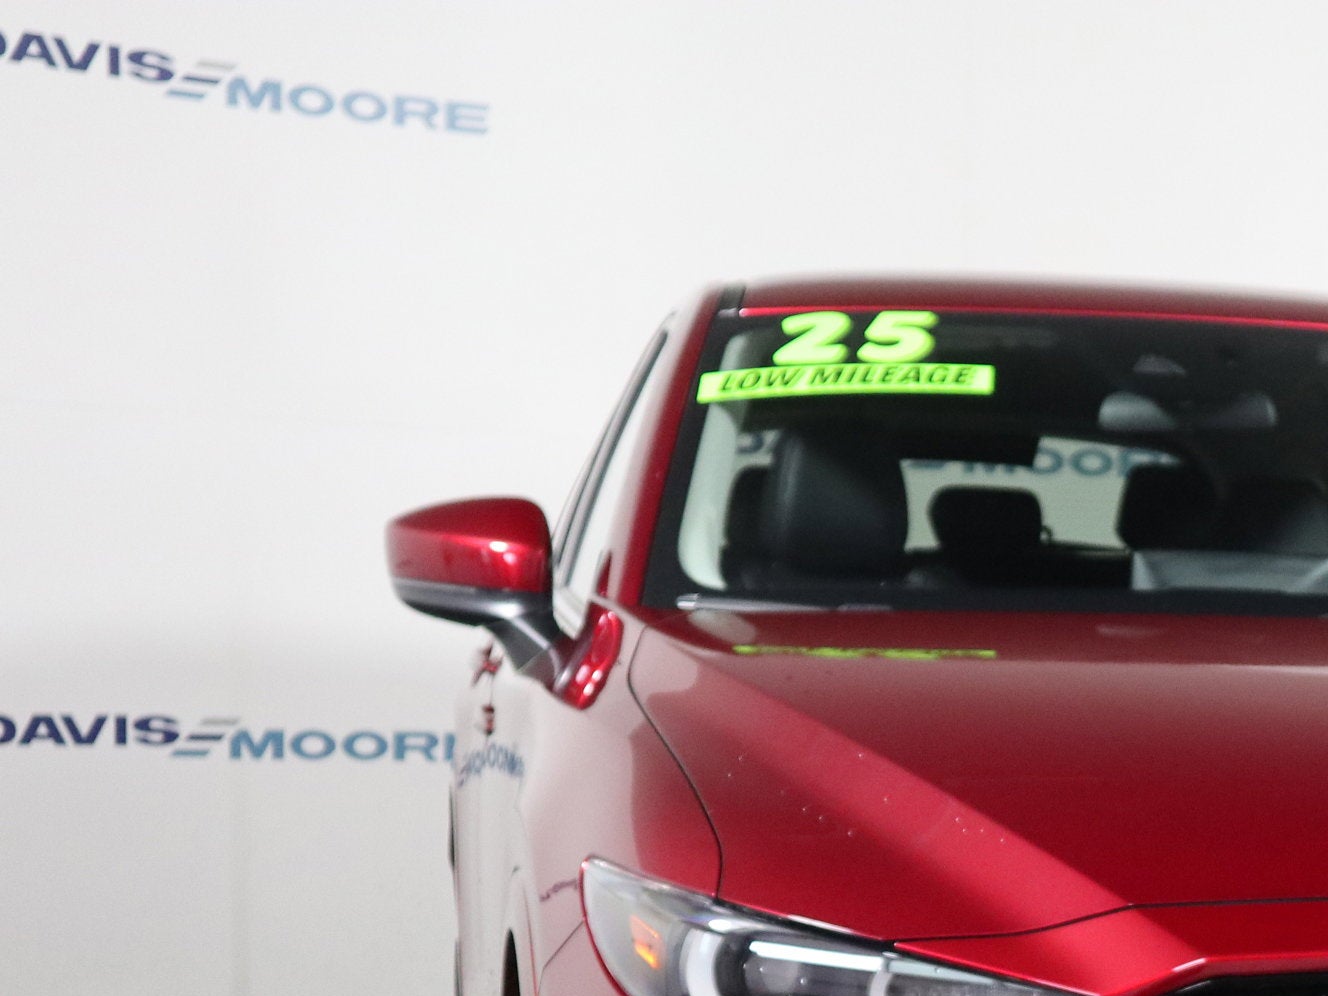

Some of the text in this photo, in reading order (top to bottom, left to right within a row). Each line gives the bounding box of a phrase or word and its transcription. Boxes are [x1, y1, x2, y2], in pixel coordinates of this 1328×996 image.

[0, 31, 490, 136] AVIS MOORE
[772, 310, 940, 365] 25
[718, 365, 975, 392] LOW MILEAGE
[229, 728, 457, 763] MOOR
